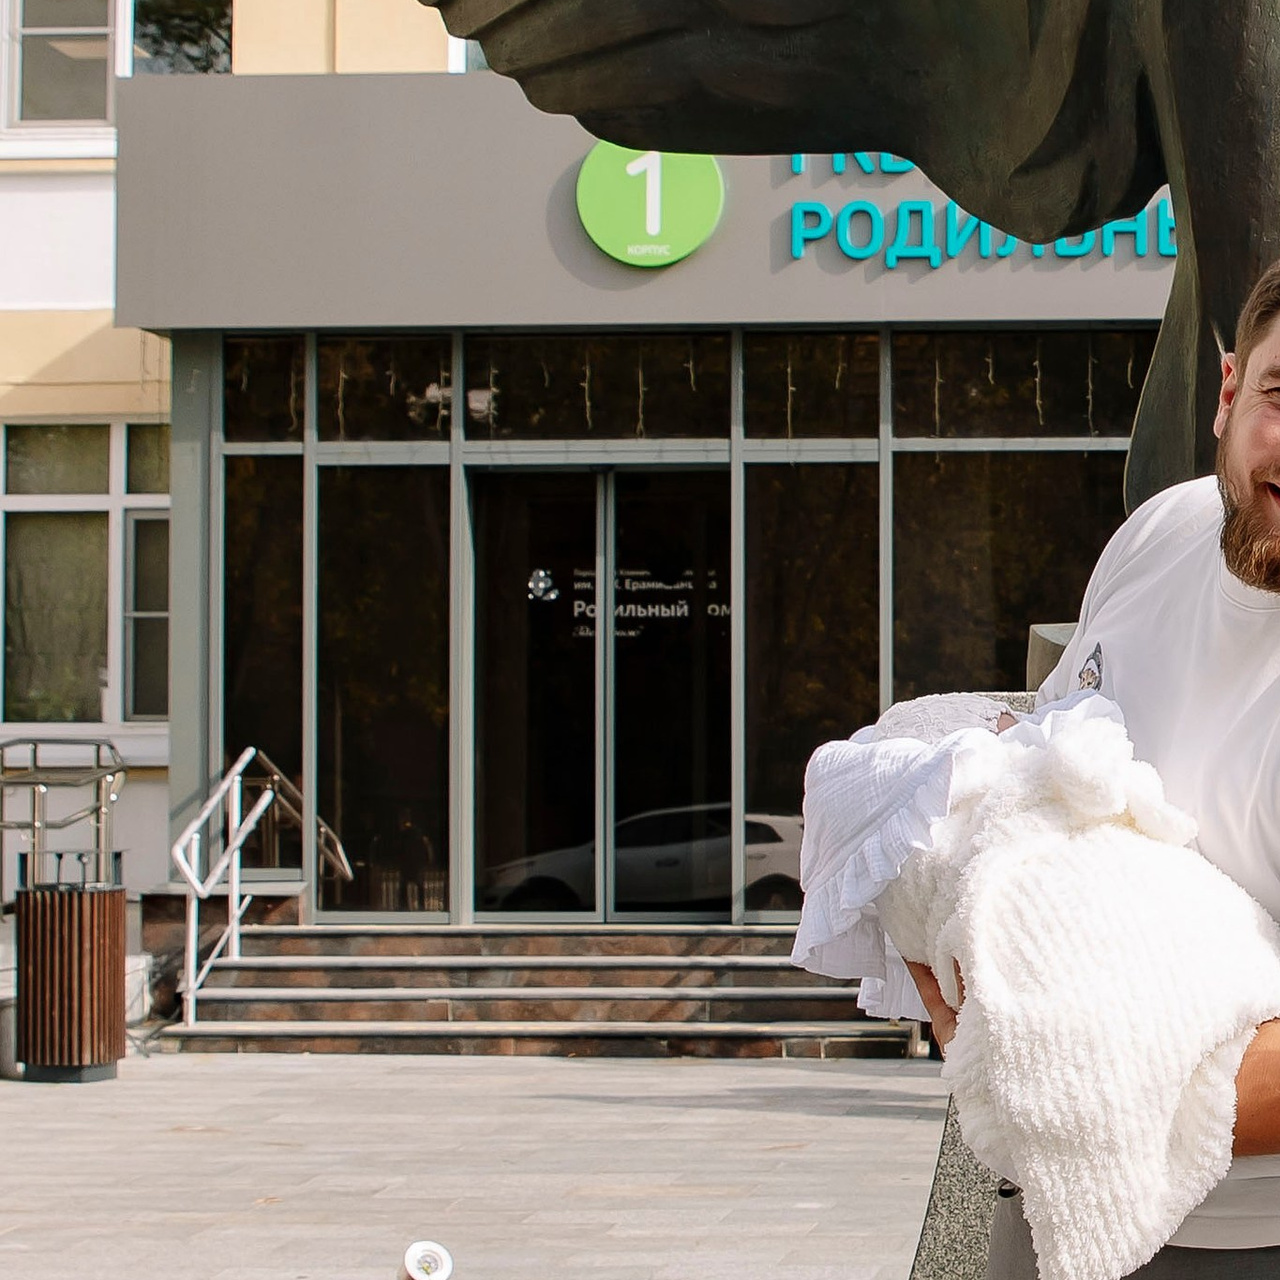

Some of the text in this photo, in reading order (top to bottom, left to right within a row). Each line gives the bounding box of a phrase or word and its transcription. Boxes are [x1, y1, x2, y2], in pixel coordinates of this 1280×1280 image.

[626, 151, 661, 236] 1
[573, 599, 732, 618] Роильный ом
